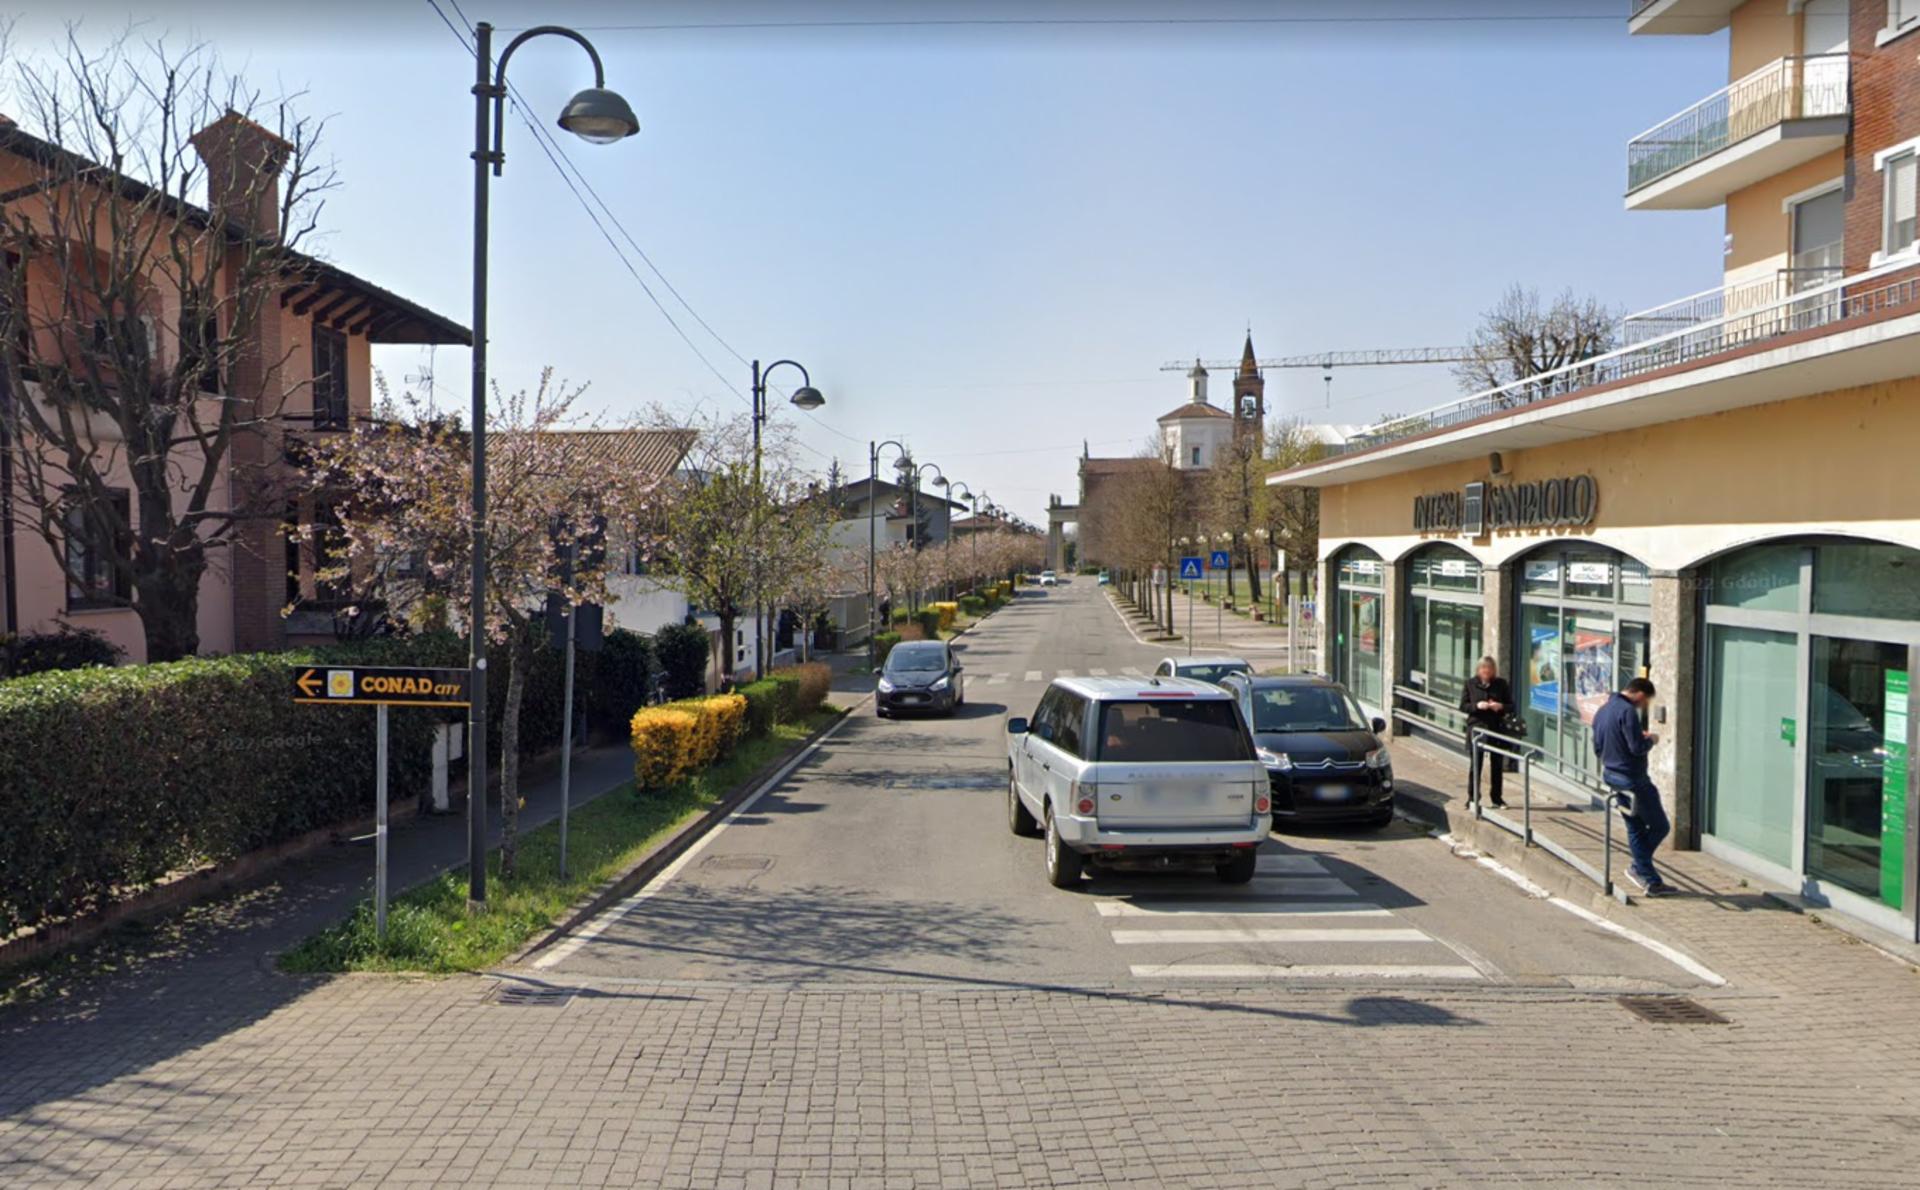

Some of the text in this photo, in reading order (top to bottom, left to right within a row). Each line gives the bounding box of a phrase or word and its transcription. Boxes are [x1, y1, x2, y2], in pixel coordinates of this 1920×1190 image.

[1486, 474, 1600, 529] SANPAOLO
[360, 675, 461, 695] CONAD CITY
